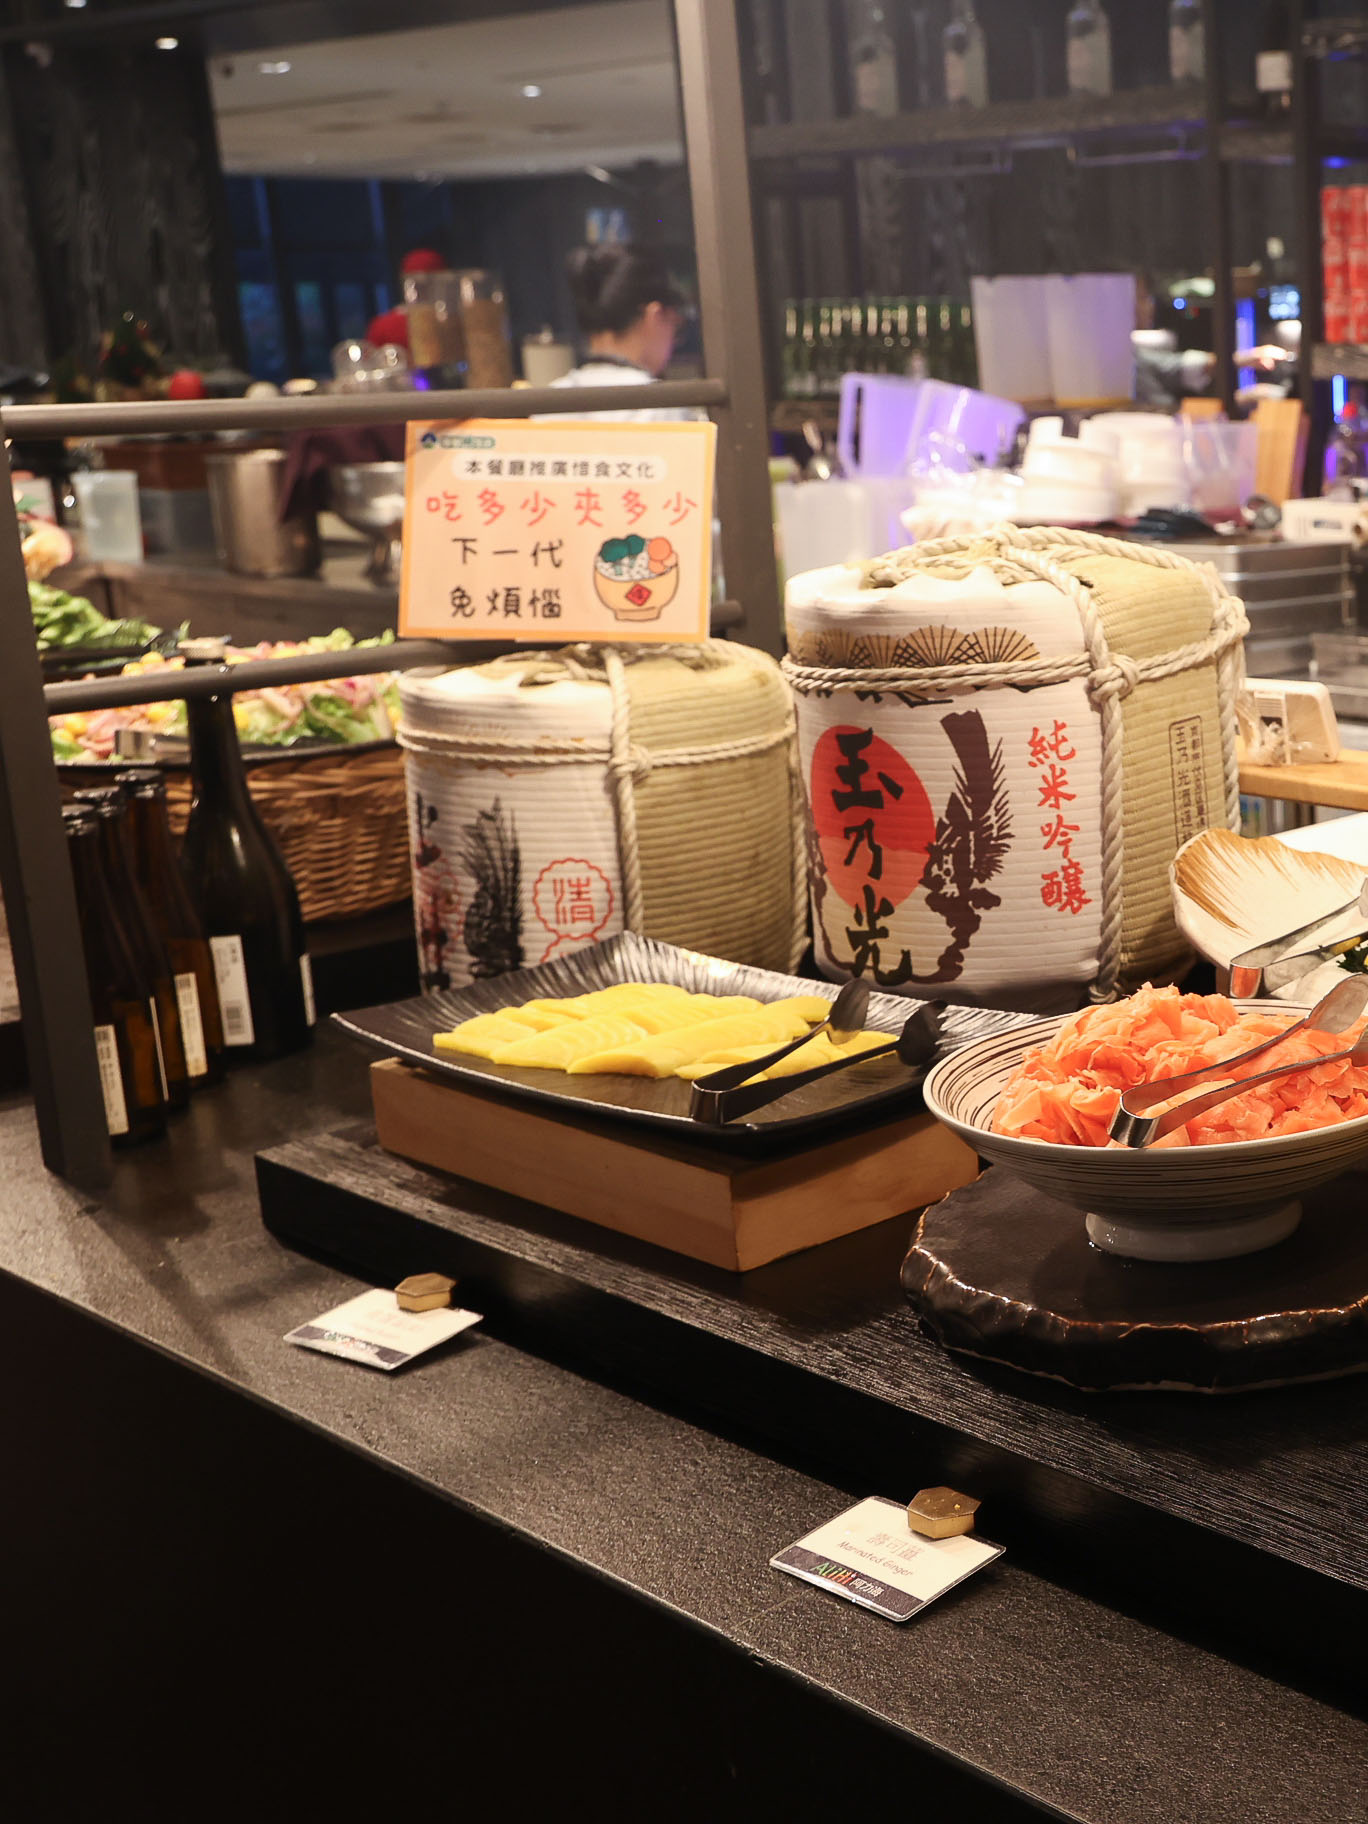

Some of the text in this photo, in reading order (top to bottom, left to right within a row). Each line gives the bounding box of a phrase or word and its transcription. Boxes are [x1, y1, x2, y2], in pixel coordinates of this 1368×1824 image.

[465, 459, 655, 479] 本餐廳推廣惜食文化
[426, 487, 697, 527] 吃多少夾多少
[451, 537, 563, 569] 下一代
[449, 586, 562, 619] 免煩惱
[832, 728, 911, 986] 玉乃光
[838, 1541, 914, 1577] Marinated Ginger
